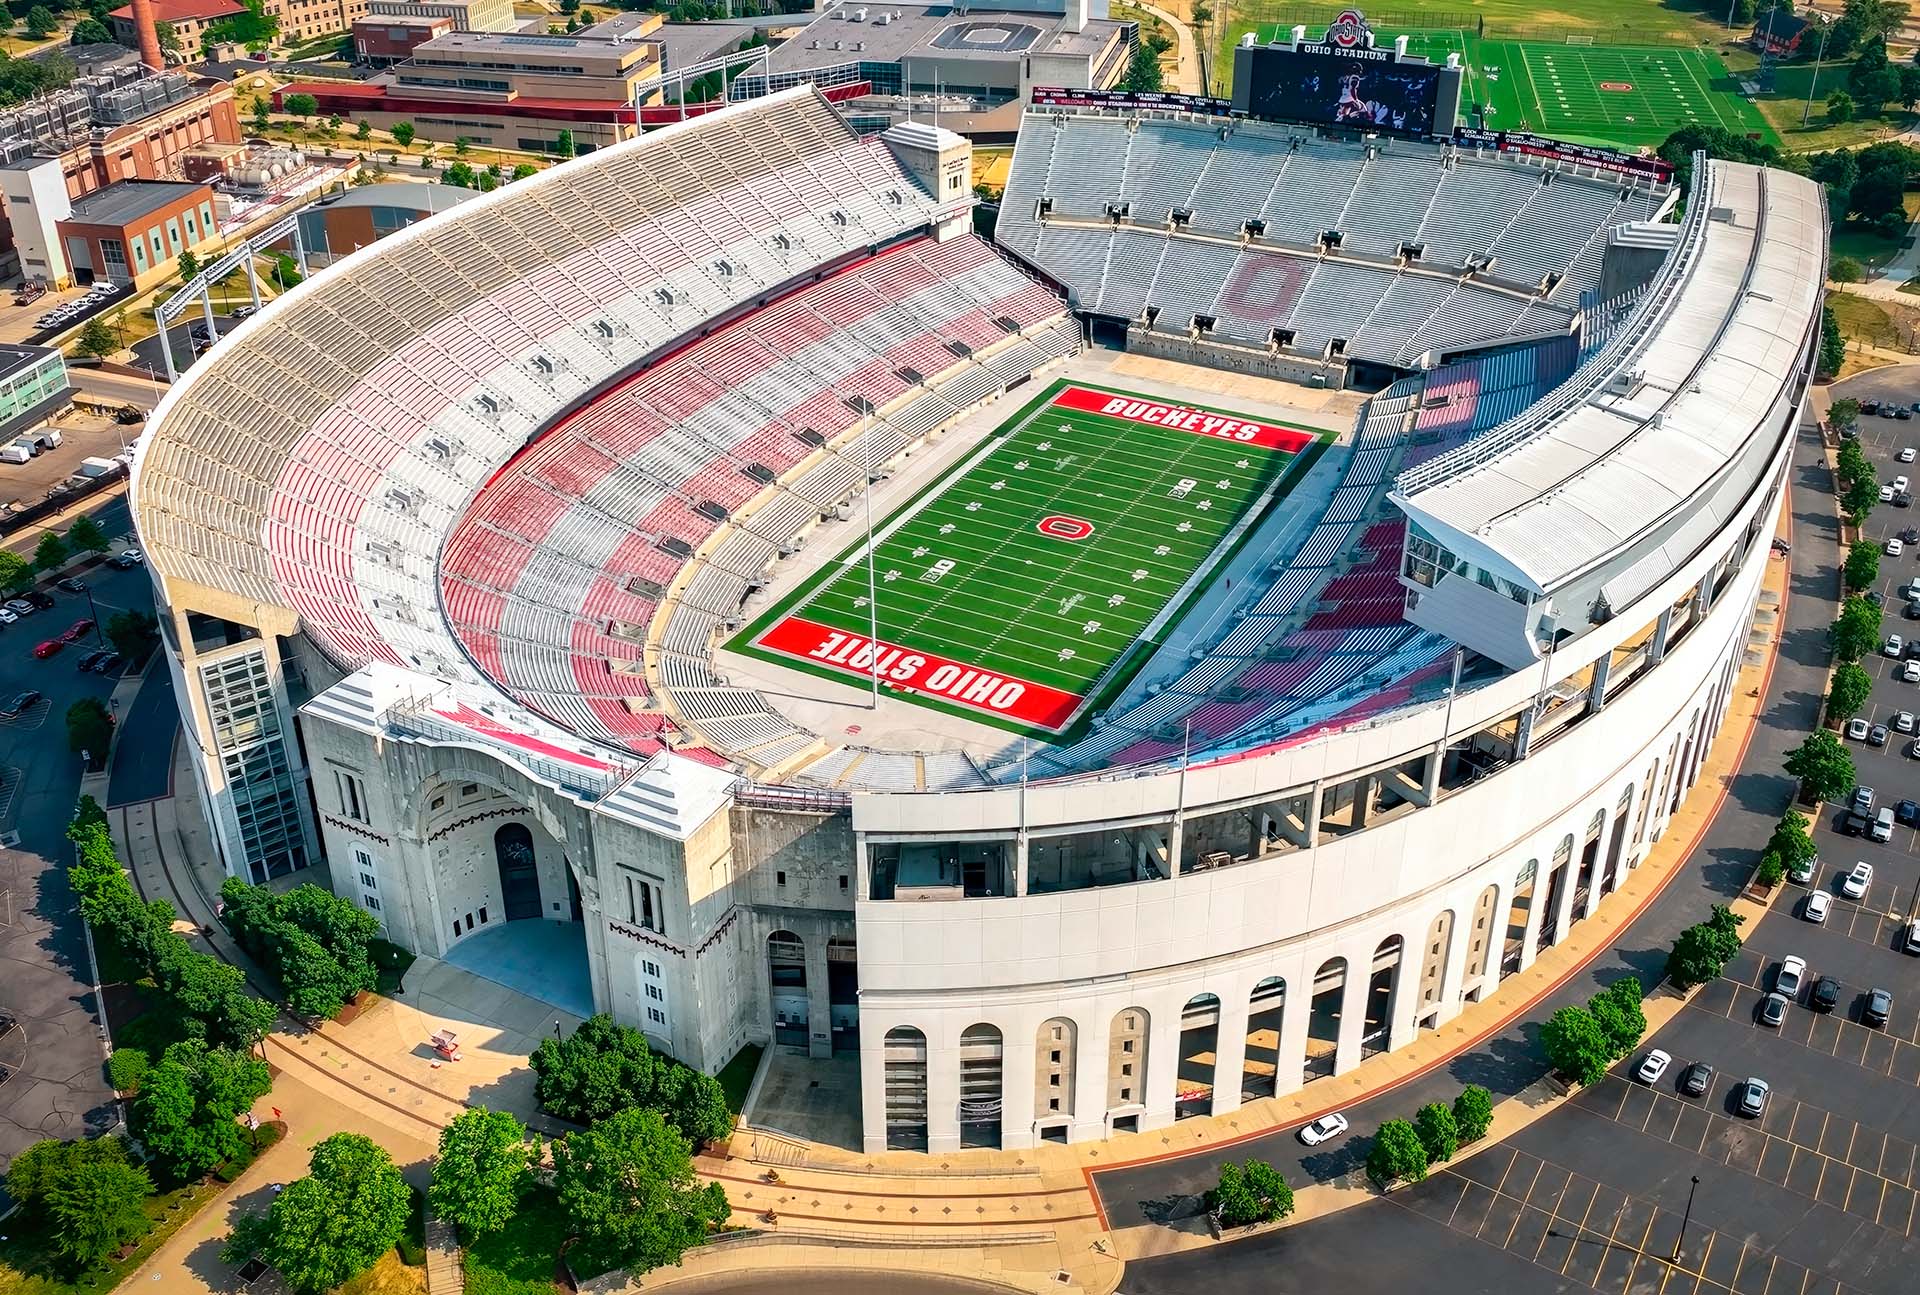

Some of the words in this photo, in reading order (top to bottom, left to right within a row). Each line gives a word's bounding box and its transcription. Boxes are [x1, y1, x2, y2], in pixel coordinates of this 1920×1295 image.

[1304, 45, 1331, 55] OHIO
[1334, 47, 1388, 61] STADIUM
[1100, 398, 1261, 441] BUCKEYES
[1153, 545, 1171, 556] 50
[1108, 594, 1126, 606] 30
[1082, 620, 1101, 633] 20
[808, 632, 926, 681] STATE
[1057, 648, 1076, 660] 10
[924, 665, 1026, 709] OHIO
